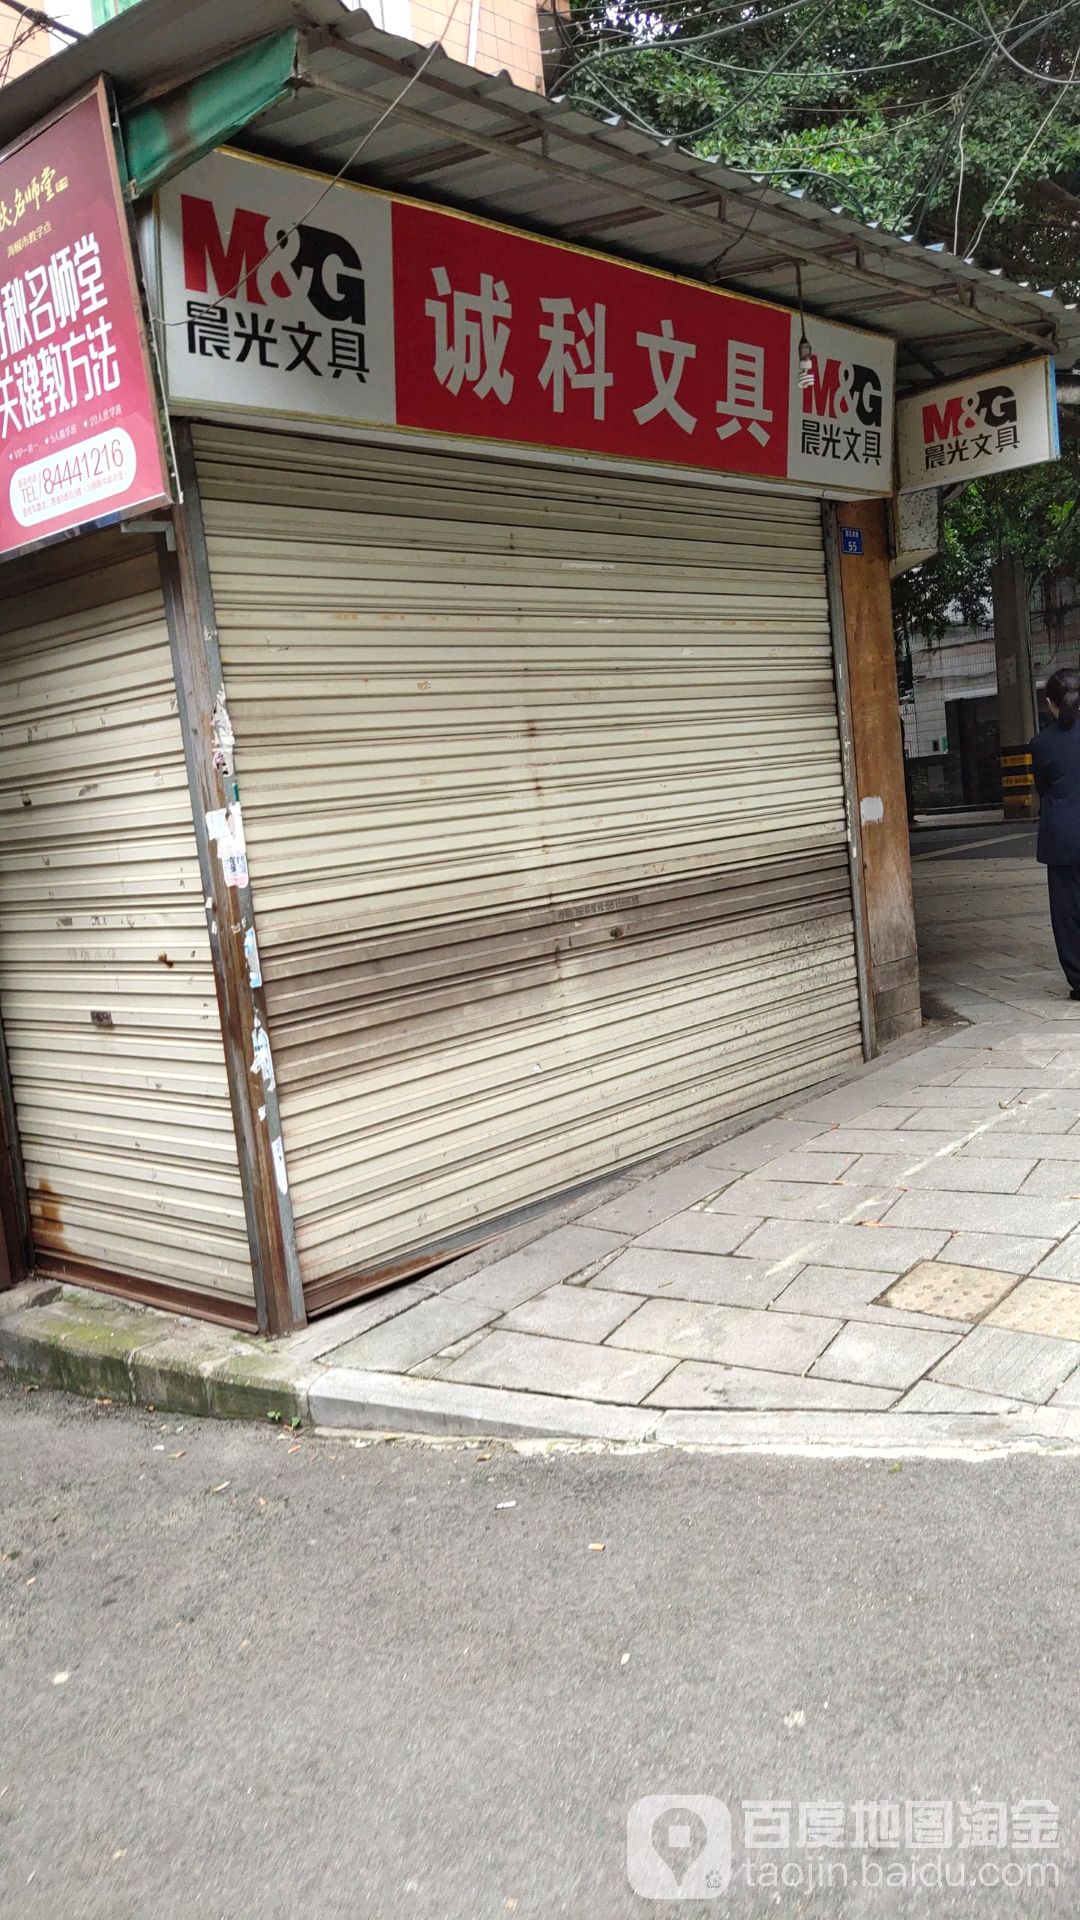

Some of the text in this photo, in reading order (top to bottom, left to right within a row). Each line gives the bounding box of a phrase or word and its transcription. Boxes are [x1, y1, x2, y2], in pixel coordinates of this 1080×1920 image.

[180, 193, 366, 326] M&G
[0, 231, 109, 361] 秋名师堂
[186, 300, 370, 384] 晨光文具
[424, 265, 774, 448] 诚科文具
[802, 354, 882, 427] M&G
[922, 385, 1018, 444] M&G
[42, 438, 124, 495] 84441216
[801, 419, 882, 466] 晨光文具
[924, 424, 1020, 470] 晨光文具
[848, 541, 858, 552] 55
